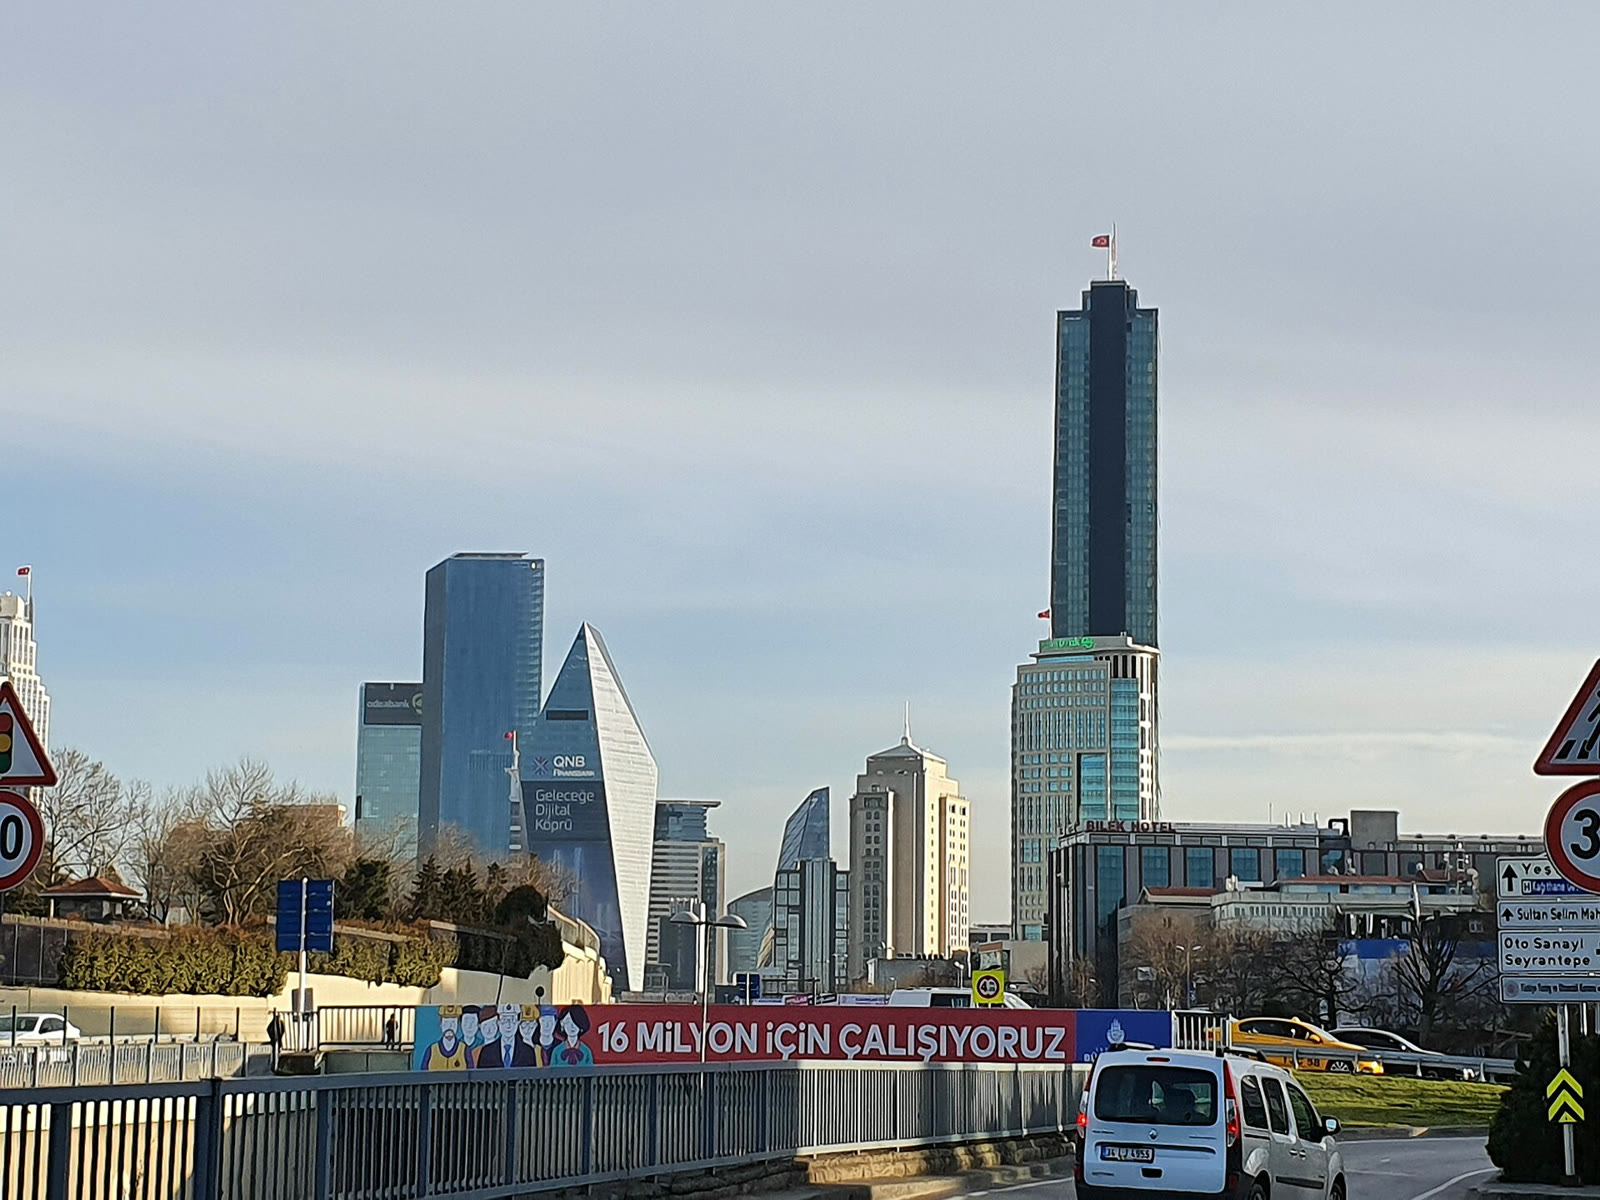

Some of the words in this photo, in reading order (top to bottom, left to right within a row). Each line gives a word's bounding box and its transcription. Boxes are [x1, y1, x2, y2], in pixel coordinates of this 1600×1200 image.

[553, 755, 586, 768] QNB
[535, 803, 571, 819] Dijital
[1131, 821, 1176, 833] HOTEL
[1570, 808, 1600, 860] 3
[0, 814, 23, 860] 0
[1517, 907, 1549, 921] Sultan
[1550, 907, 1578, 921] Selim
[1504, 937, 1529, 949] Oto
[1505, 954, 1591, 968] Seyrantepe
[598, 1021, 629, 1052] 16
[838, 1023, 1067, 1063] ÇALIŞIYORUZ
